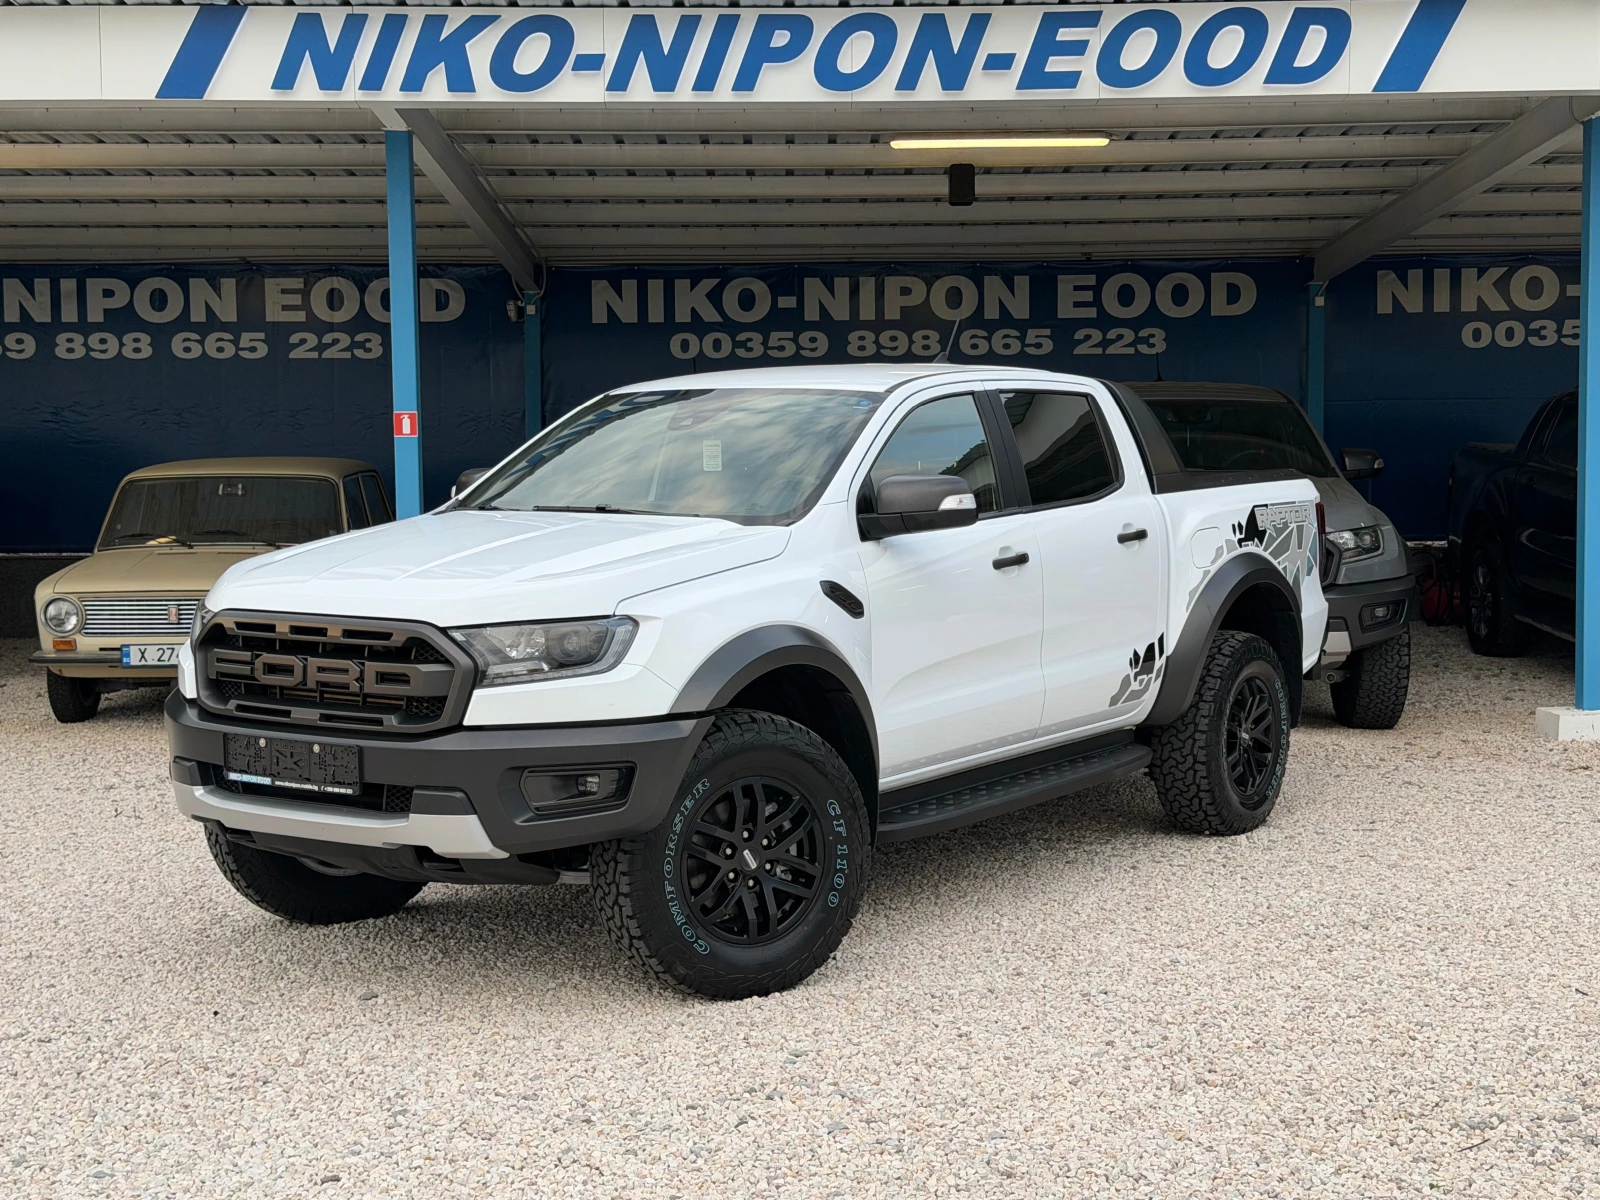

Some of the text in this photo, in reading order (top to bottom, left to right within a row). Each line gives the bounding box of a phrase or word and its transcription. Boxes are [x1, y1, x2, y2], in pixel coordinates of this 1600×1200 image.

[271, 7, 1352, 93] NIKO-NIPON-EOOD
[3, 277, 237, 323] NIPON
[591, 272, 1257, 324] NIKO-NIPON EOOD
[0, 331, 384, 360] 9 898 665 223
[669, 327, 1167, 360] 00359 898 665 223
[1254, 505, 1314, 532] RAPTOR
[137, 647, 179, 663] X 27
[208, 648, 426, 696] FORD
[664, 778, 711, 954] COMFORSER
